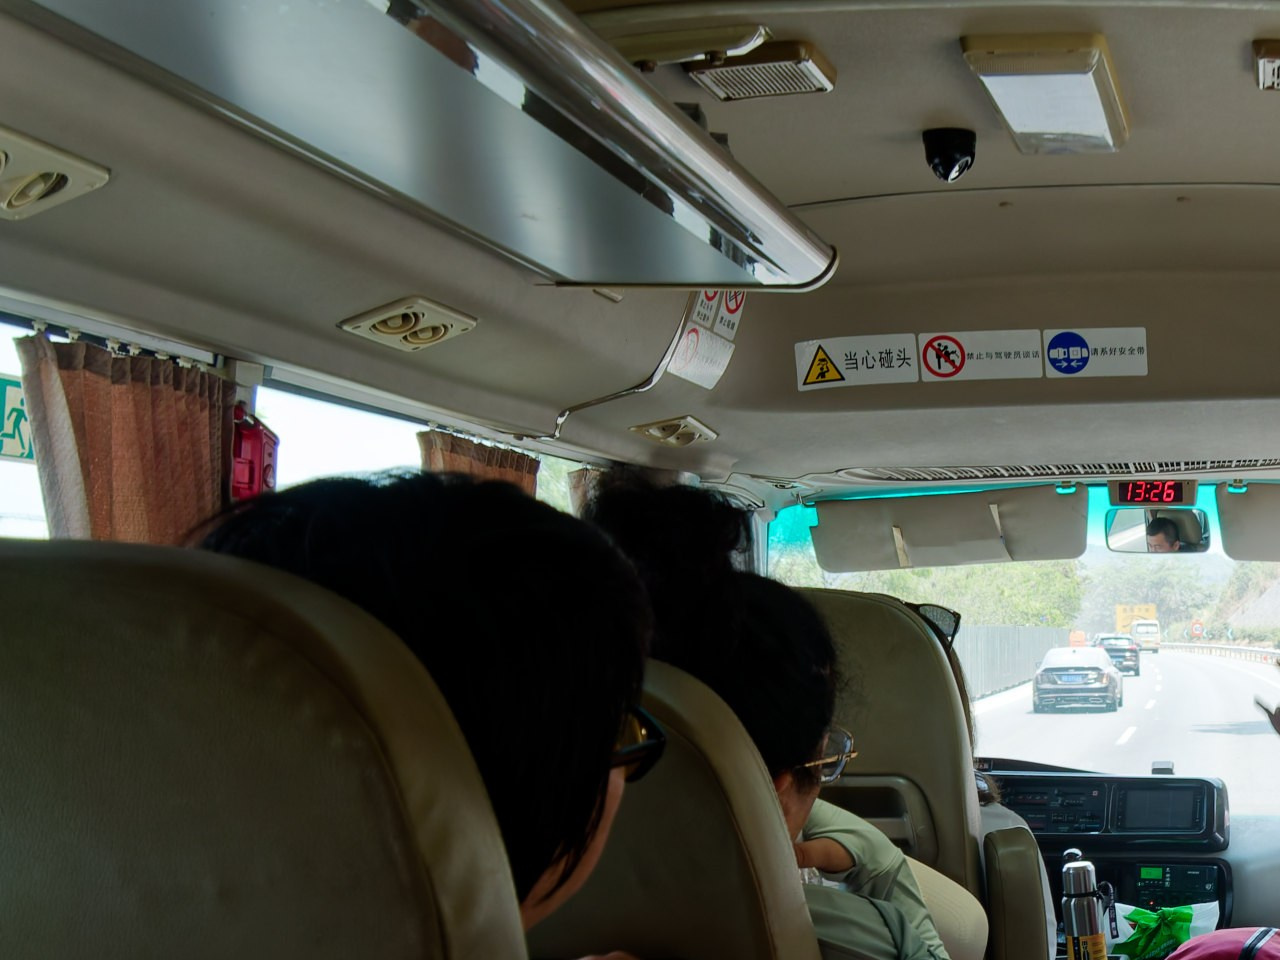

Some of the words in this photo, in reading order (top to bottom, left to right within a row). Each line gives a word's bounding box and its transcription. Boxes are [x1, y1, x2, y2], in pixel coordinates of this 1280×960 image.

[844, 347, 912, 371] 当心碰头
[1090, 346, 1145, 357] 请系好安全带
[1127, 480, 1175, 502] 13:26
